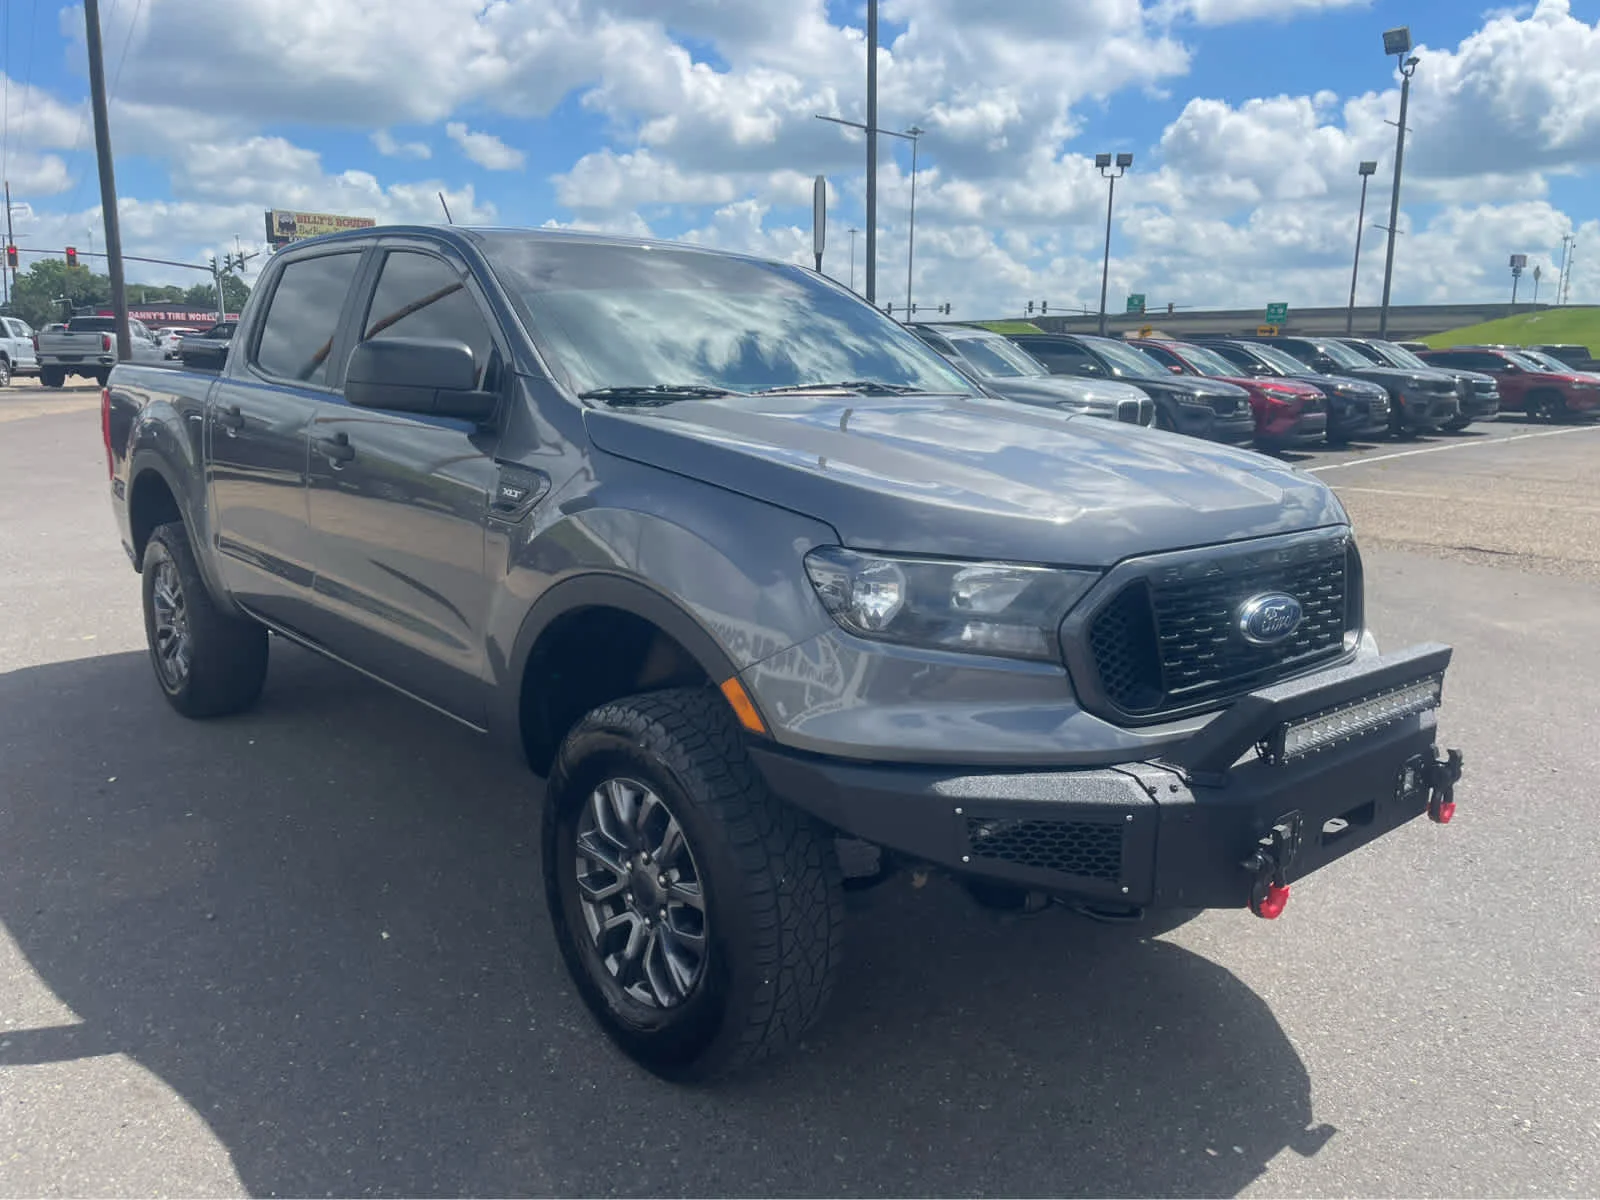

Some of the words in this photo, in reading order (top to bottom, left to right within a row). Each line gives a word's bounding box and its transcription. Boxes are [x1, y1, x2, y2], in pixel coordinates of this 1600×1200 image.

[128, 311, 165, 320] DANNY'S
[168, 311, 187, 321] TIRE
[503, 487, 522, 498] XLT
[1261, 604, 1292, 634] Ford
